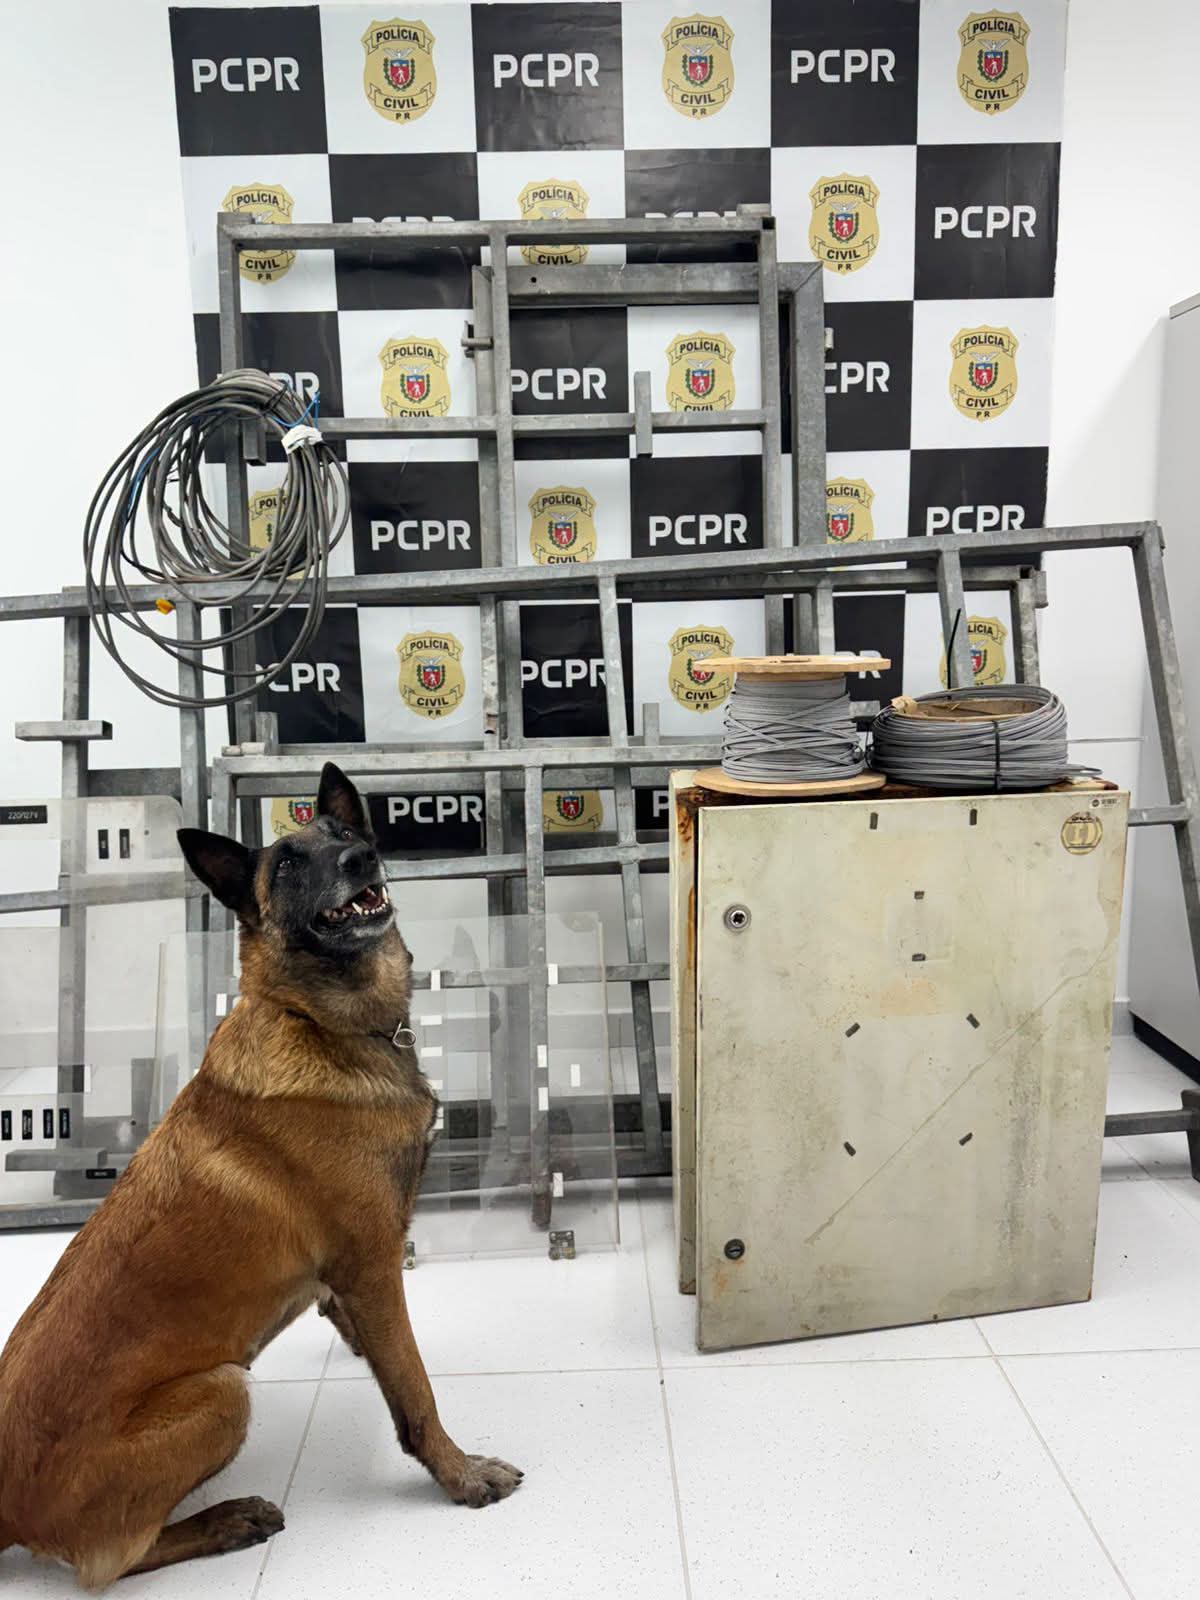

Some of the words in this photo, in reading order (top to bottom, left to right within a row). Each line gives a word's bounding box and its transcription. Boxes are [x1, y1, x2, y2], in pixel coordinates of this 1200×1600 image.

[376, 26, 420, 42] POLÍCIA
[676, 21, 719, 38] POLÍCIA
[973, 19, 1015, 34] POLÍCIA
[493, 53, 600, 88] PCPR
[790, 49, 896, 83] PCPR
[191, 58, 300, 92] PCPR
[680, 93, 716, 105] CIVIL
[974, 89, 1010, 99] CIVIL
[383, 98, 419, 109] CIVIL
[532, 186, 575, 202] POLÍCIA
[823, 181, 866, 197] POLÍCIA
[236, 191, 279, 206] POLÍCIA
[934, 206, 1037, 239] PCPR
[537, 255, 573, 266] CIVIL
[826, 249, 861, 260] CIVIL
[245, 258, 280, 270] CIVIL
[679, 338, 721, 353] POLÍCIA
[963, 333, 1005, 348] POLÍCIA
[393, 344, 435, 359] POLÍCIA
[510, 367, 607, 401] PCPR
[966, 397, 999, 408] CIVIL
[826, 486, 861, 498] OLÍCIA
[542, 494, 583, 508] POLÍCIA
[925, 504, 1026, 537] PCPR
[370, 520, 471, 551] PCPR
[649, 514, 747, 546] PCPR
[547, 555, 581, 565] CIVIL
[967, 624, 994, 636] LÍCIA
[410, 639, 450, 651] POLÍCIA
[681, 632, 721, 646] POLÍCIA
[520, 658, 607, 689] PCPR
[416, 697, 450, 707] CIVIL
[685, 691, 718, 701] CIVIL
[388, 796, 482, 824] PCPR
